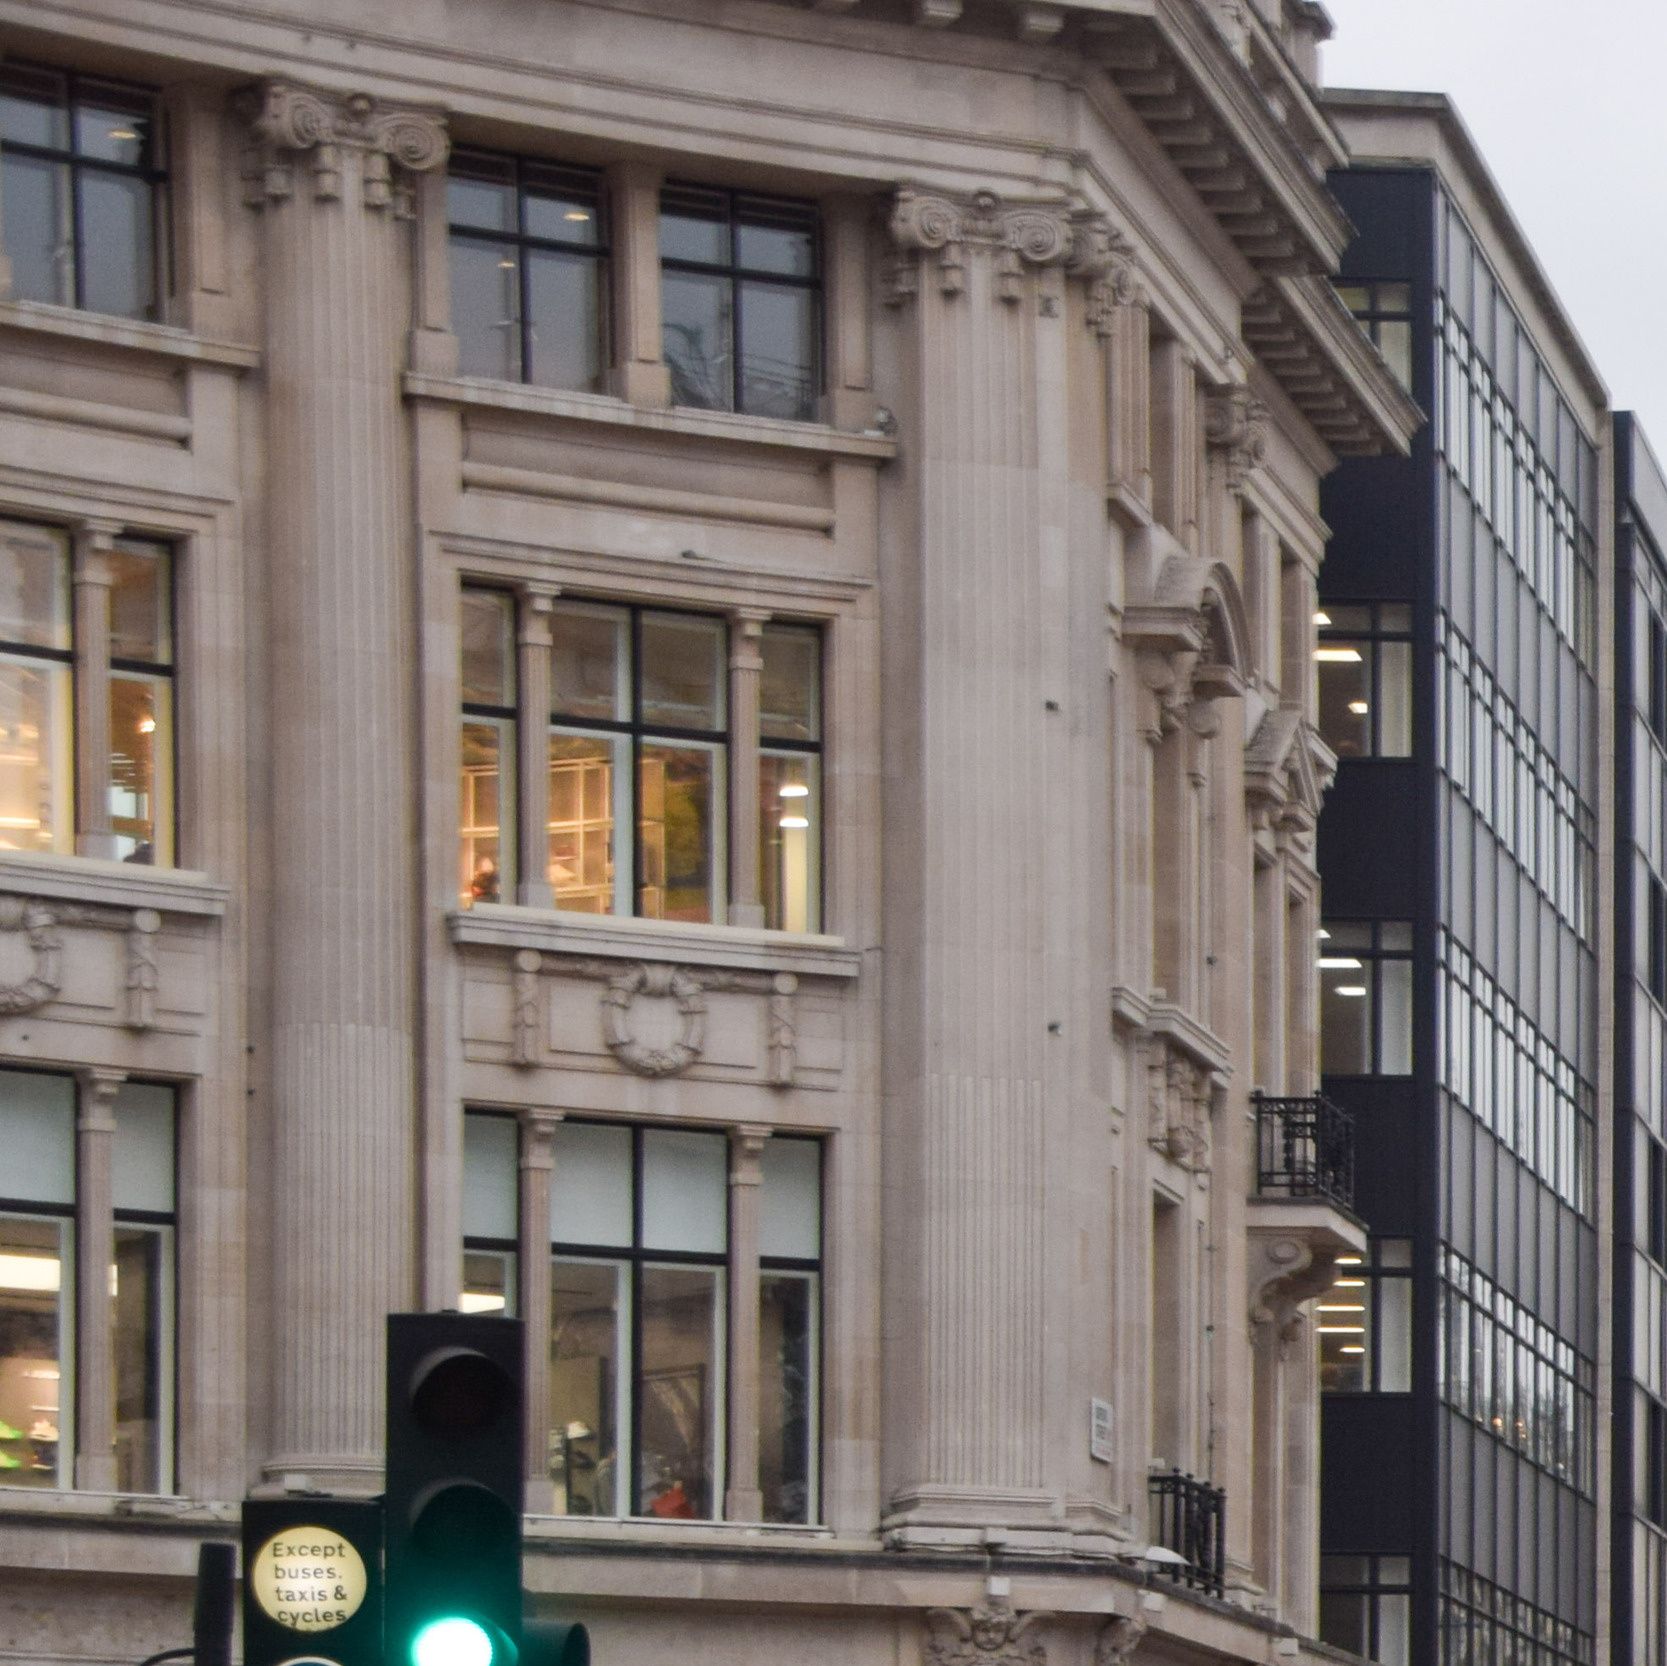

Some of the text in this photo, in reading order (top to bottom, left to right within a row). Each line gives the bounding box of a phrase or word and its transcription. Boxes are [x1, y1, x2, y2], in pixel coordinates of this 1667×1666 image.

[272, 1541, 346, 1559] Except
[275, 1584, 348, 1602] taxis &
[277, 1607, 347, 1629] cycles
